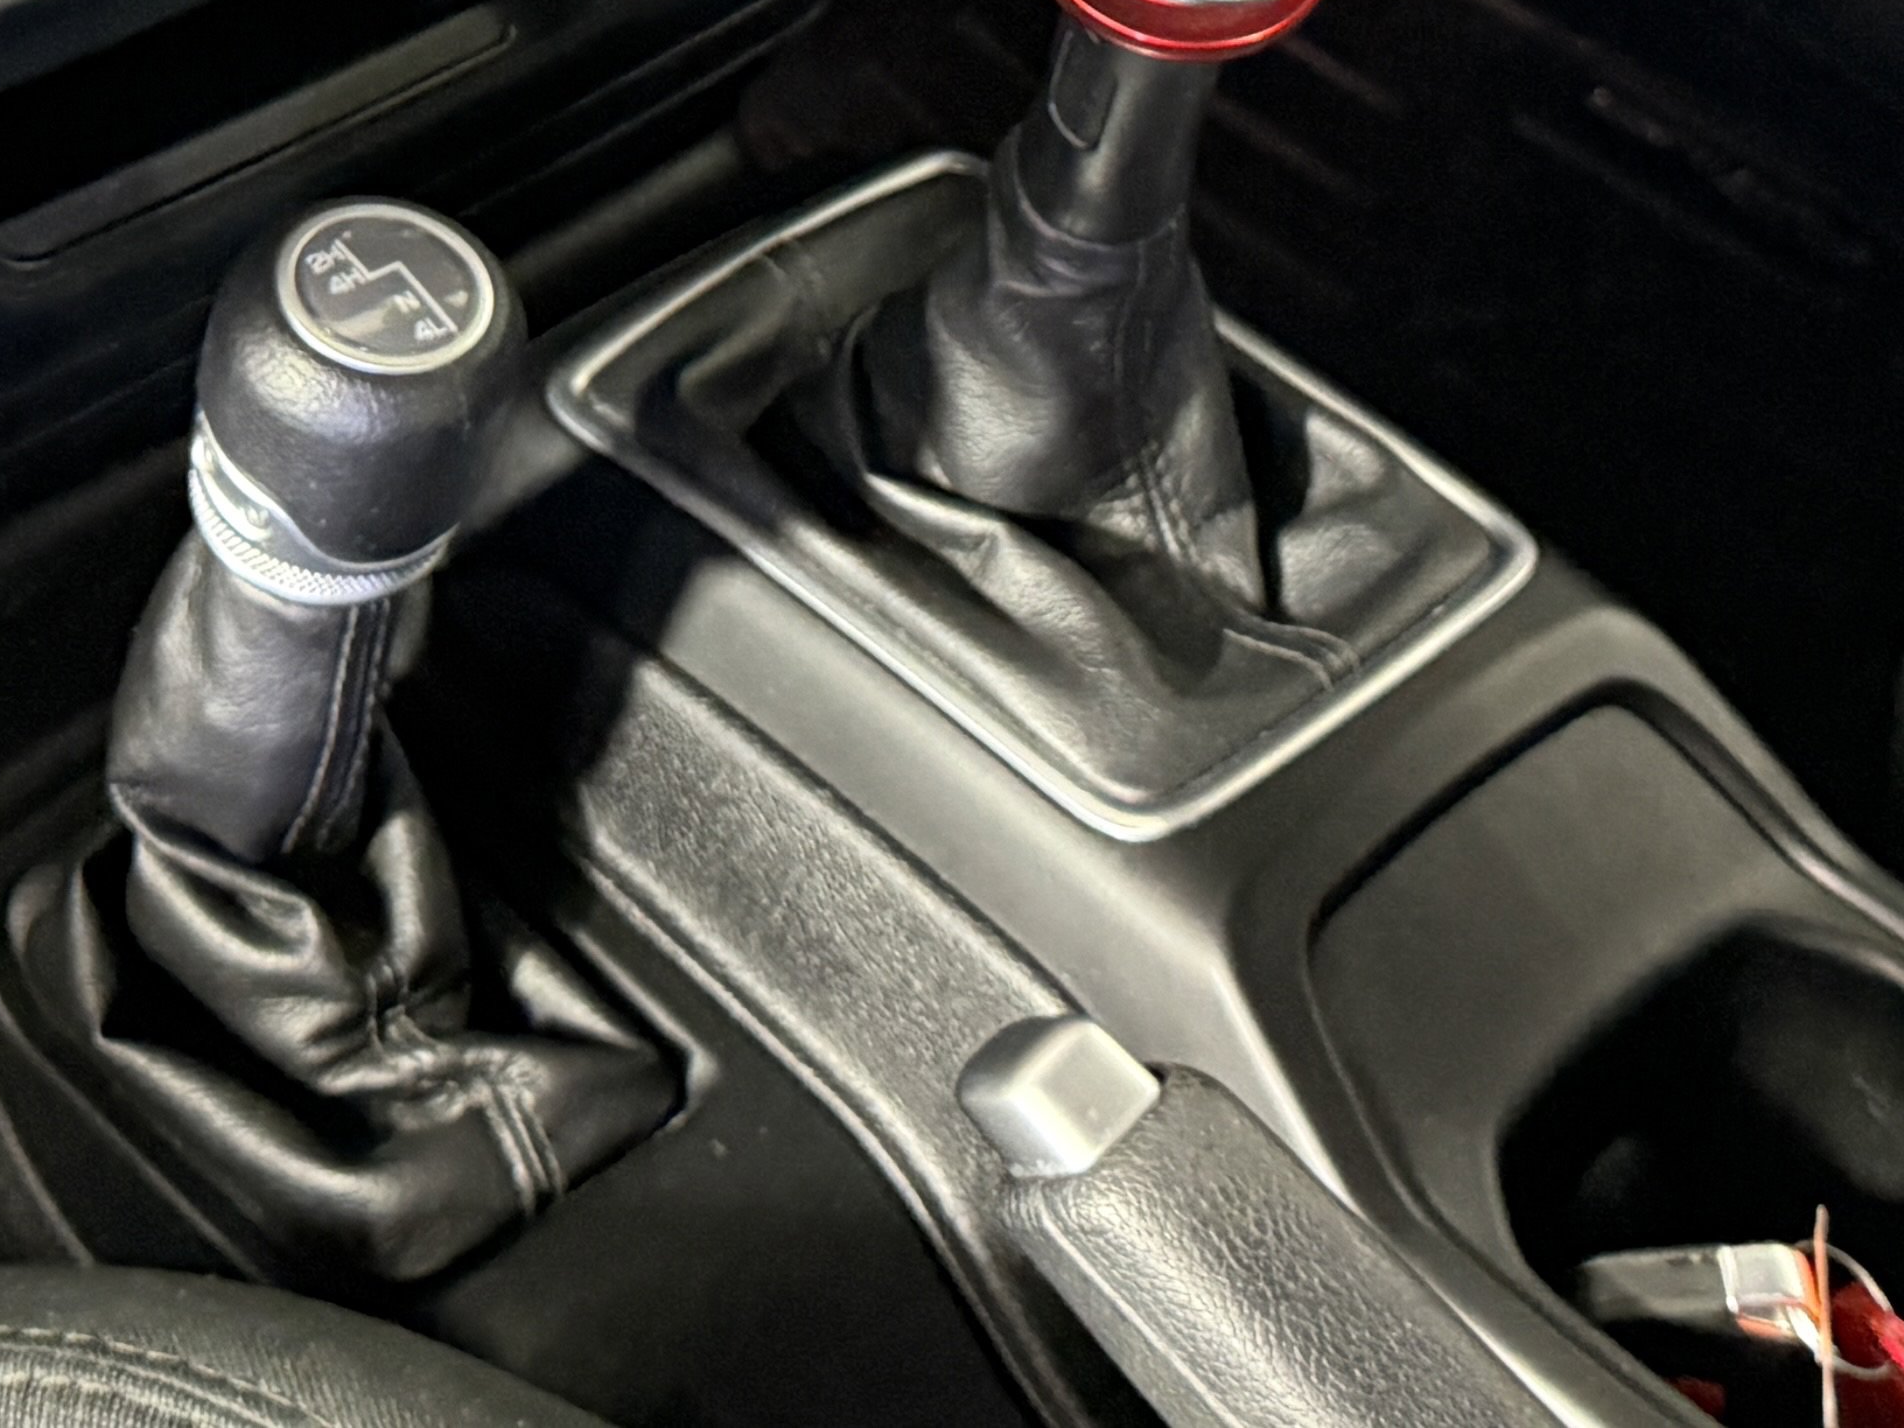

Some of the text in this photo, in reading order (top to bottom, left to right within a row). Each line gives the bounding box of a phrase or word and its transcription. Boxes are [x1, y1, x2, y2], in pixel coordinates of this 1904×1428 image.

[305, 239, 346, 274] 2H
[329, 269, 367, 296] 4H
[394, 290, 422, 314] N
[415, 316, 451, 341] 4L
